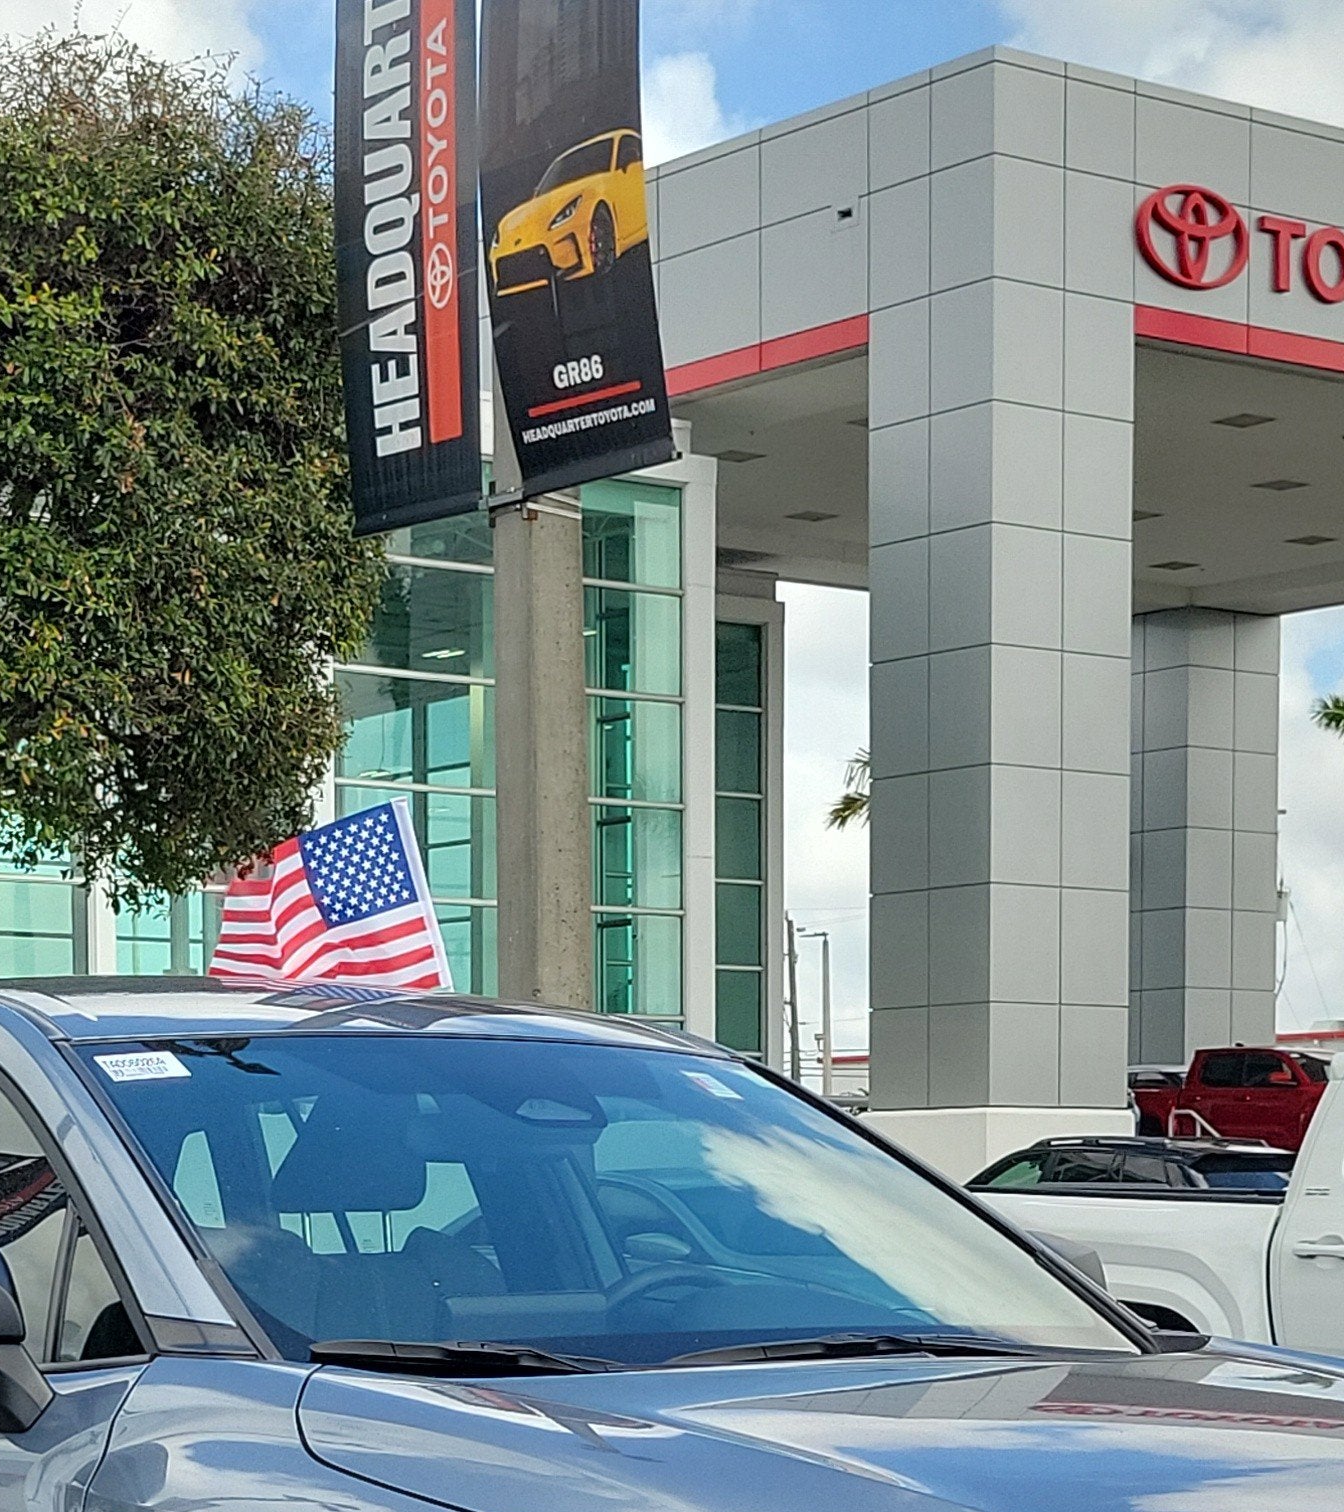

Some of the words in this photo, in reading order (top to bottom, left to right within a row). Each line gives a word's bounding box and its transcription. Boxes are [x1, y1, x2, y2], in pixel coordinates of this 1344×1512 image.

[426, 17, 449, 237] TOYOTA
[553, 354, 603, 389] GR86
[521, 398, 656, 445] HEADQUARTERTOYOTA.COM
